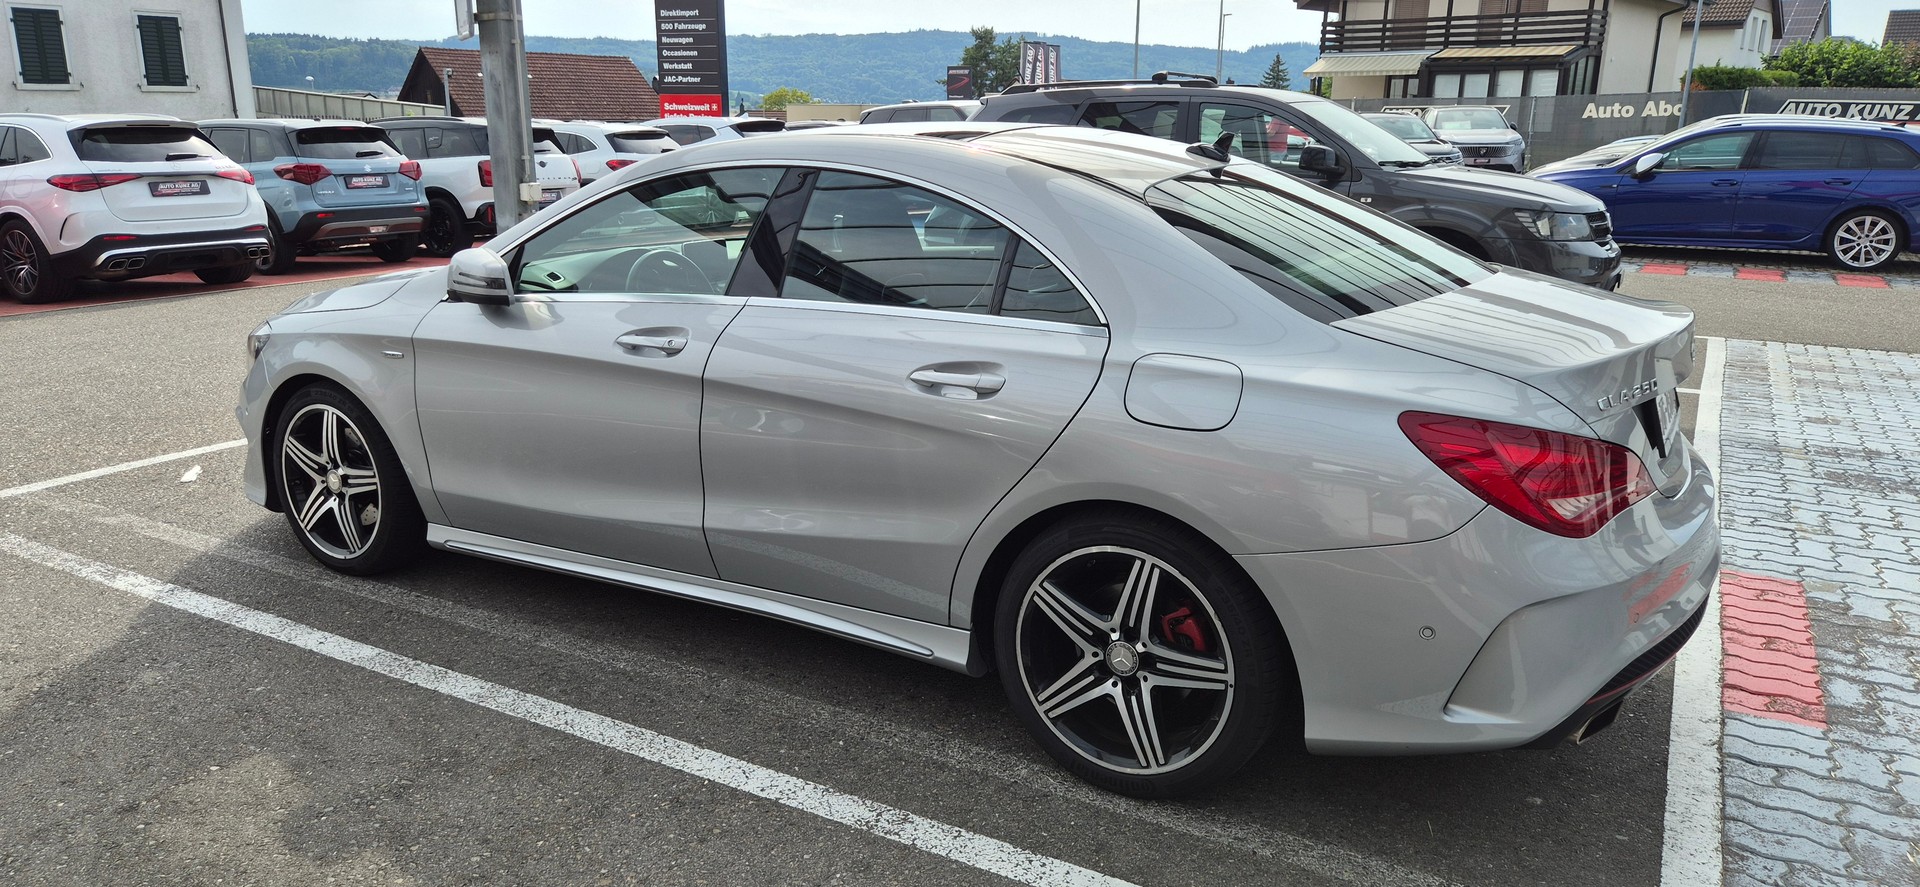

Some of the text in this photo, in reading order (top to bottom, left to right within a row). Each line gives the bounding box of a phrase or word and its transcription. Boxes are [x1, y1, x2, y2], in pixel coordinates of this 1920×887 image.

[660, 9, 699, 17] Direktimport
[674, 22, 706, 30] Fahrzeuge
[662, 36, 693, 44] Neuwagen
[662, 62, 693, 70] Werkstatt
[663, 75, 701, 83] JAC-Partner
[663, 102, 710, 111] Schweizweit
[1582, 102, 1635, 119] Auto
[1781, 102, 1914, 121] AUTO KUNZ
[1597, 389, 1629, 411] CLA
